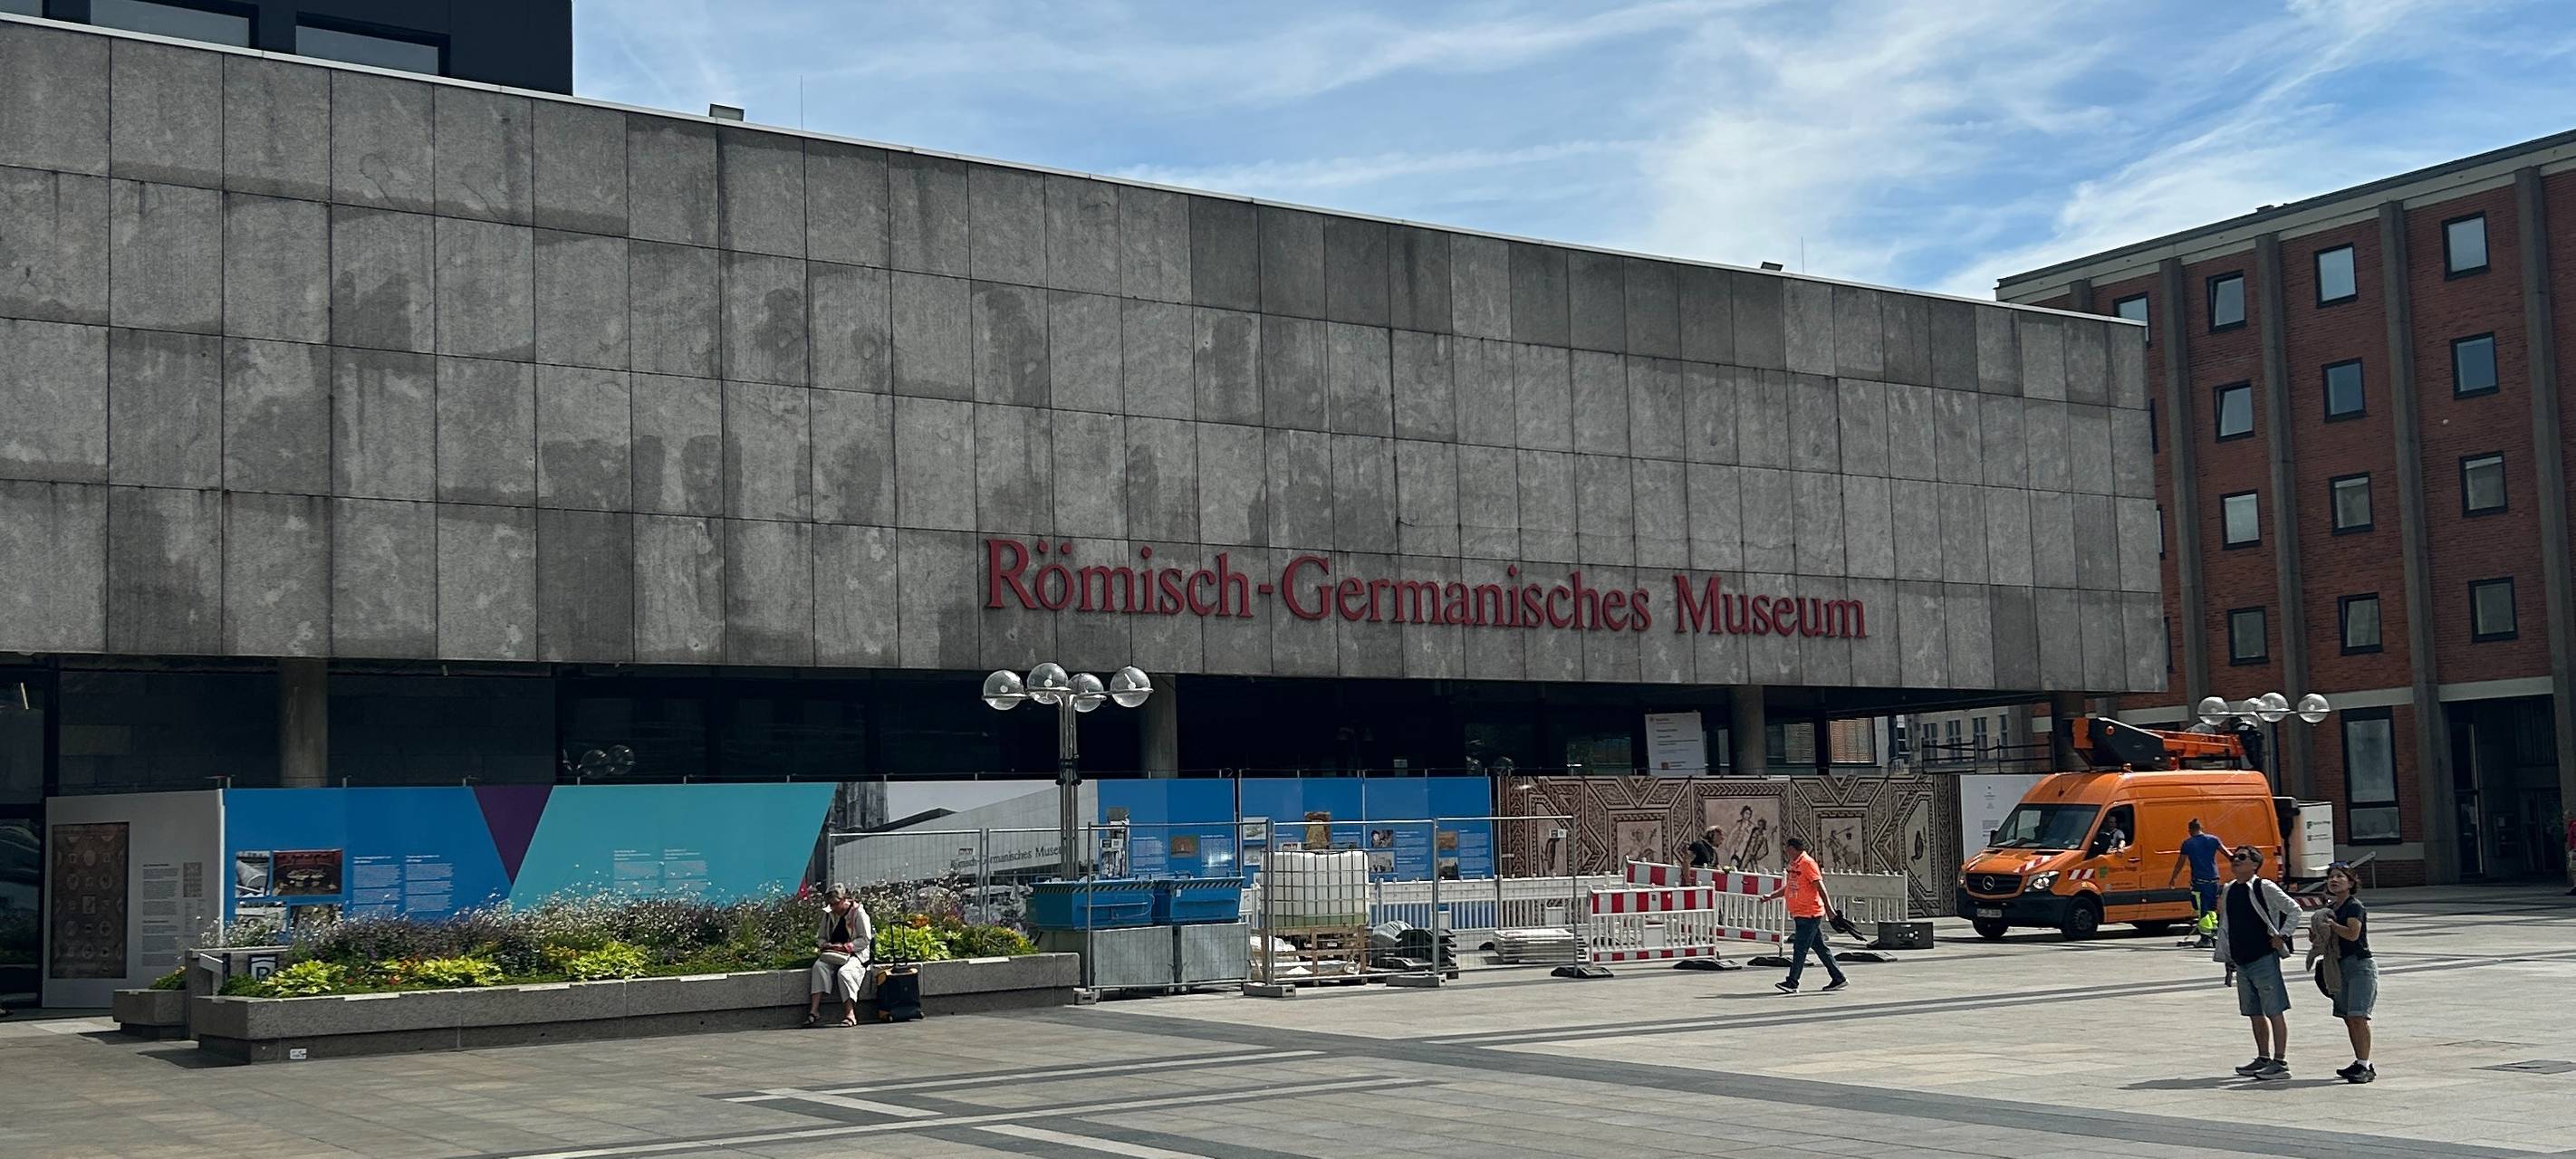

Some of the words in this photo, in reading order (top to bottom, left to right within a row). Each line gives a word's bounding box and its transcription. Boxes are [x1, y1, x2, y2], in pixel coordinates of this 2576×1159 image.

[985, 540, 1650, 632] Römisch-Germanisches
[1675, 574, 1867, 639] Museum
[256, 967, 271, 982] P
